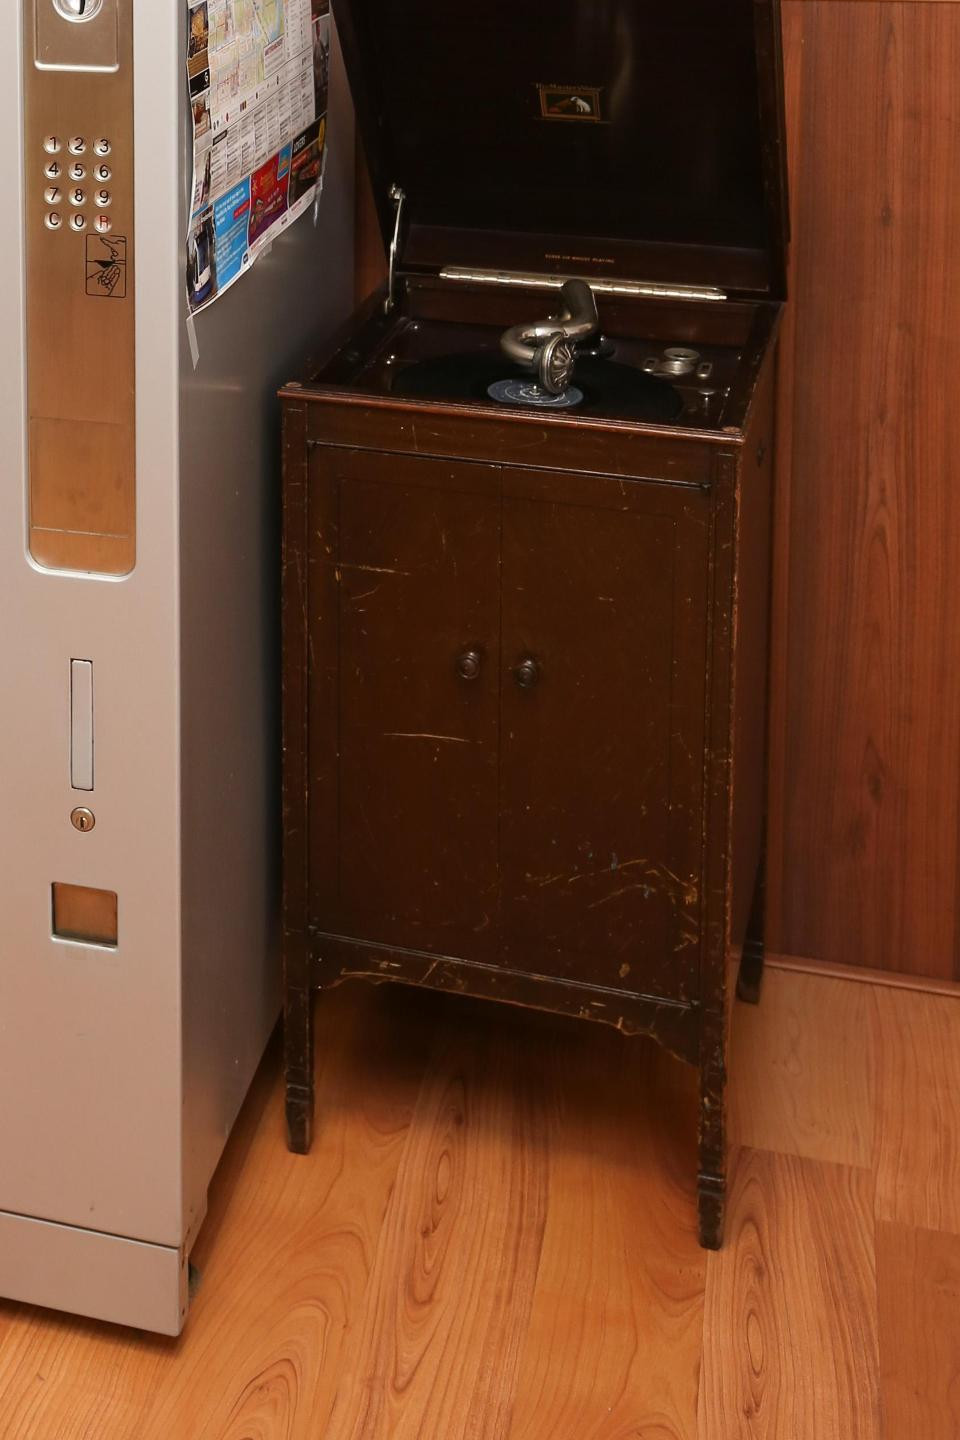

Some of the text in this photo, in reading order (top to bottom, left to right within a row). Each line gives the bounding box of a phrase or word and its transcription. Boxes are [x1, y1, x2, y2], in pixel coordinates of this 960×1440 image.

[50, 137, 56, 150] 1
[74, 137, 83, 151] 2
[99, 139, 109, 153] 3
[48, 162, 58, 175] 4
[74, 163, 83, 176] 5
[100, 164, 109, 178] 6
[50, 187, 59, 200] 7
[75, 189, 83, 202] 8
[99, 189, 109, 203] 9
[49, 212, 59, 226] C
[100, 215, 109, 229] R
